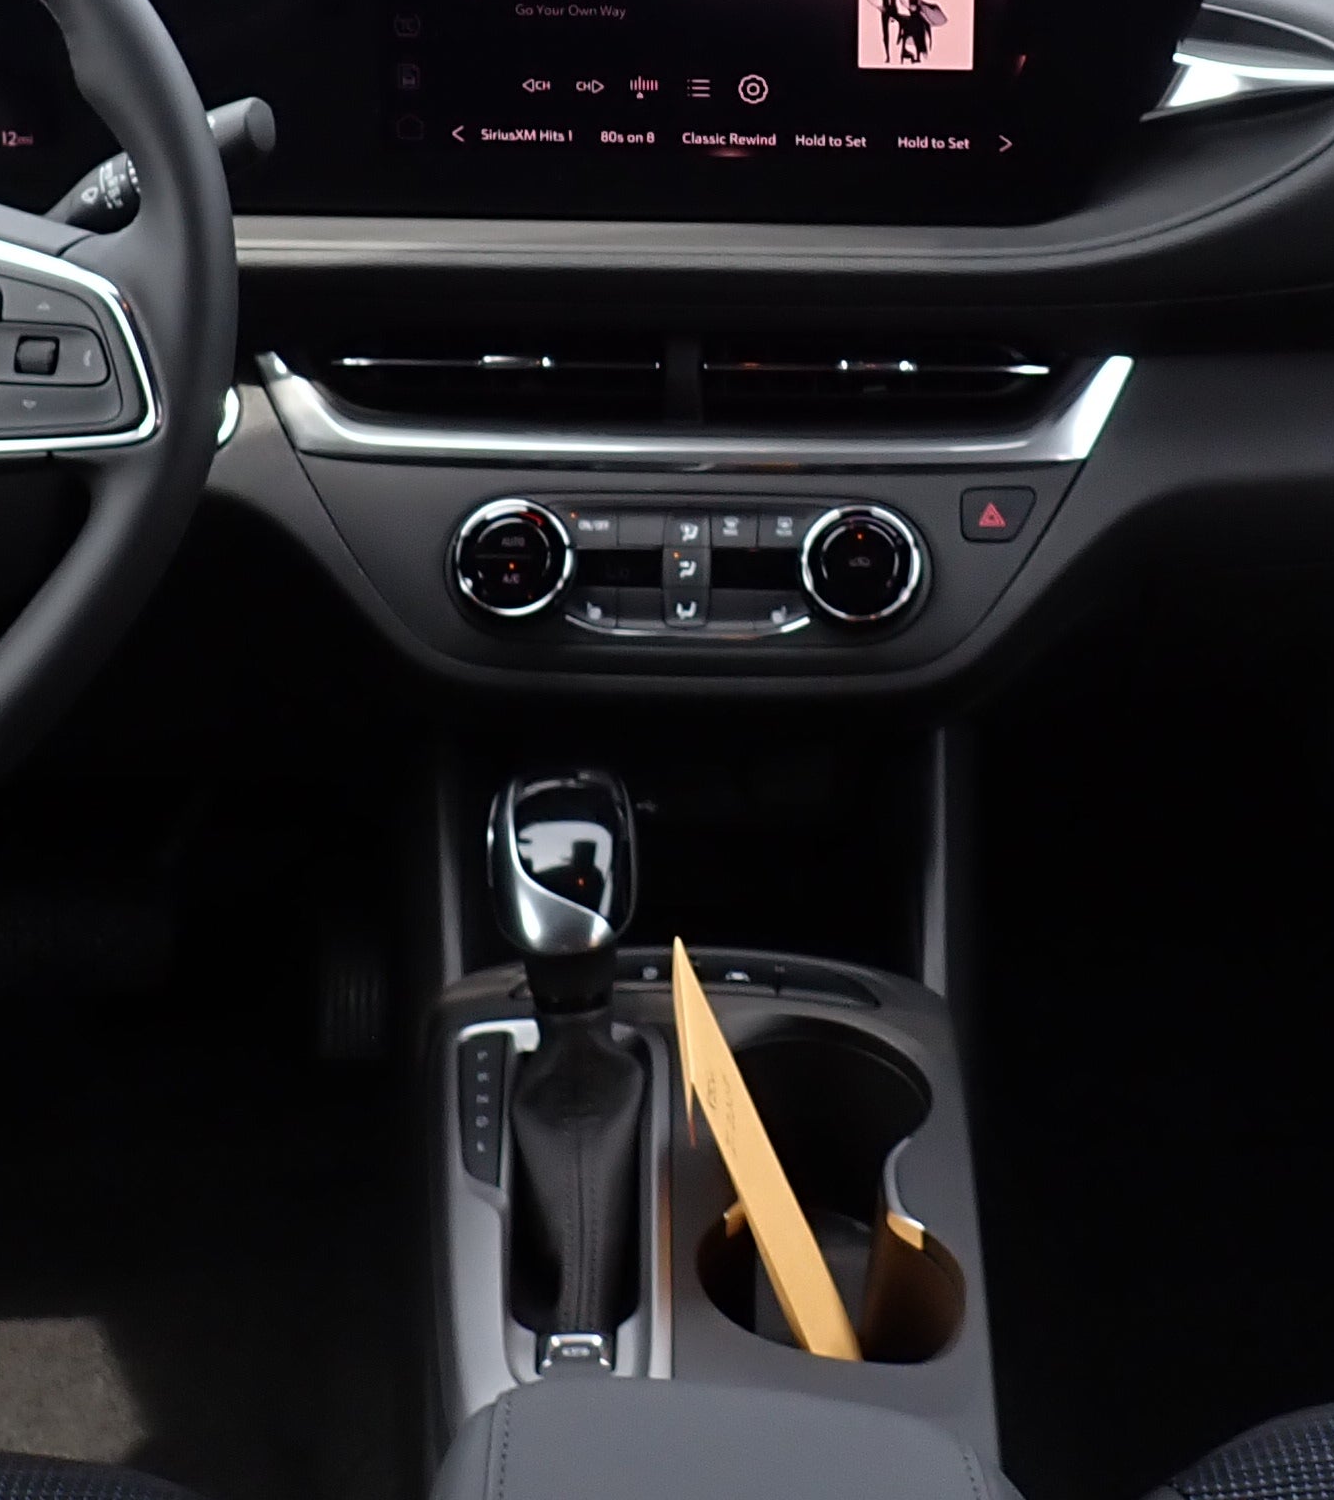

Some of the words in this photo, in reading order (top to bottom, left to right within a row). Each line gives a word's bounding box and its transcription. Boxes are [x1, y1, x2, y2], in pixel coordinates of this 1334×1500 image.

[514, 3, 534, 17] Go
[536, 4, 565, 17] Your
[567, 4, 598, 17] Own
[599, 5, 627, 20] Way
[480, 128, 537, 142] SiriusXM
[539, 129, 565, 142] Hits
[600, 130, 624, 143] 80s
[626, 133, 644, 144] on
[646, 131, 655, 144] 8
[681, 131, 727, 146] Classic
[729, 132, 777, 147] Rewind
[794, 134, 826, 148] Hold
[828, 135, 843, 148] to
[845, 134, 867, 148] Set
[897, 135, 929, 149] Hold
[931, 137, 946, 149] to
[947, 136, 970, 150] Set
